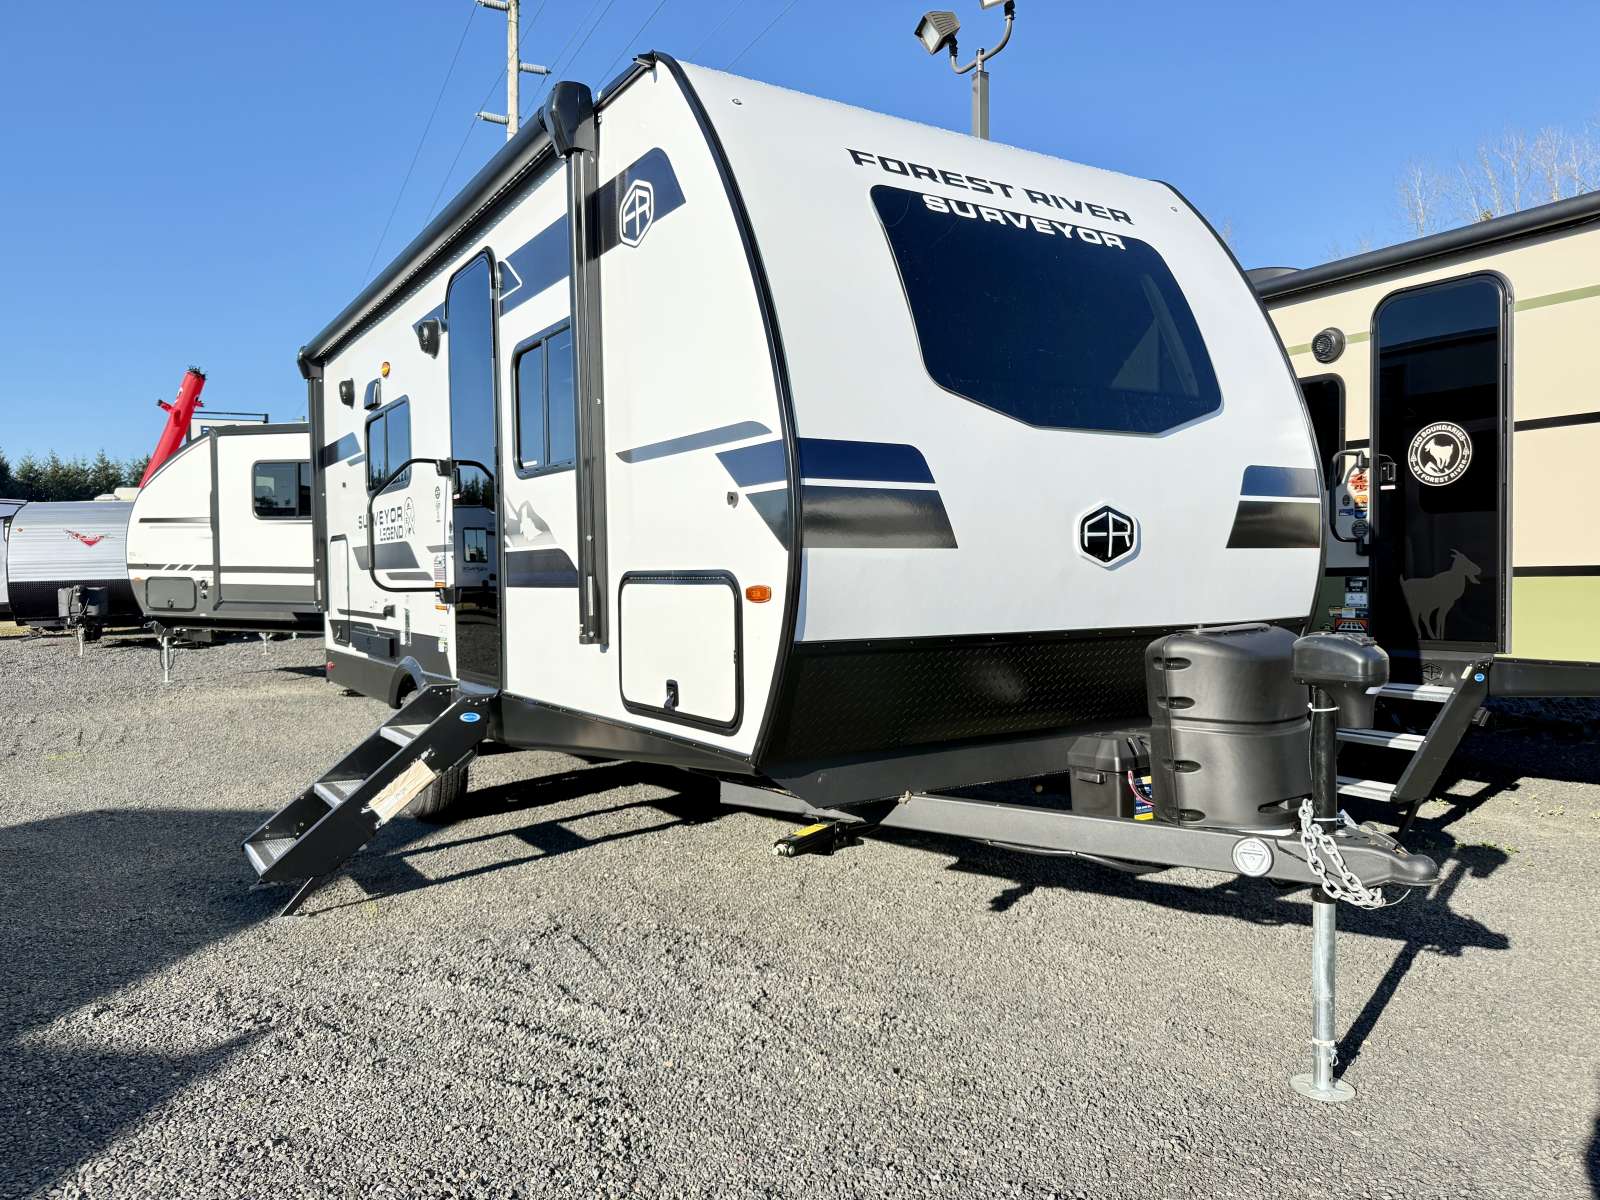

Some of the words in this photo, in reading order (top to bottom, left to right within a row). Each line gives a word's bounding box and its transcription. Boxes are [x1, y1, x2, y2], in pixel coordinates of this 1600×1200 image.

[845, 149, 1014, 199] FOREST
[1022, 188, 1135, 225] RIVER
[922, 194, 1126, 250] SURVEYOR
[1414, 436, 1423, 448] NO
[1421, 424, 1466, 441] BOUNDARIES
[1421, 473, 1449, 483] FOREST
[1449, 459, 1468, 479] RIVER
[358, 506, 403, 530] SUVEYOR
[379, 525, 403, 541] LEGEND
